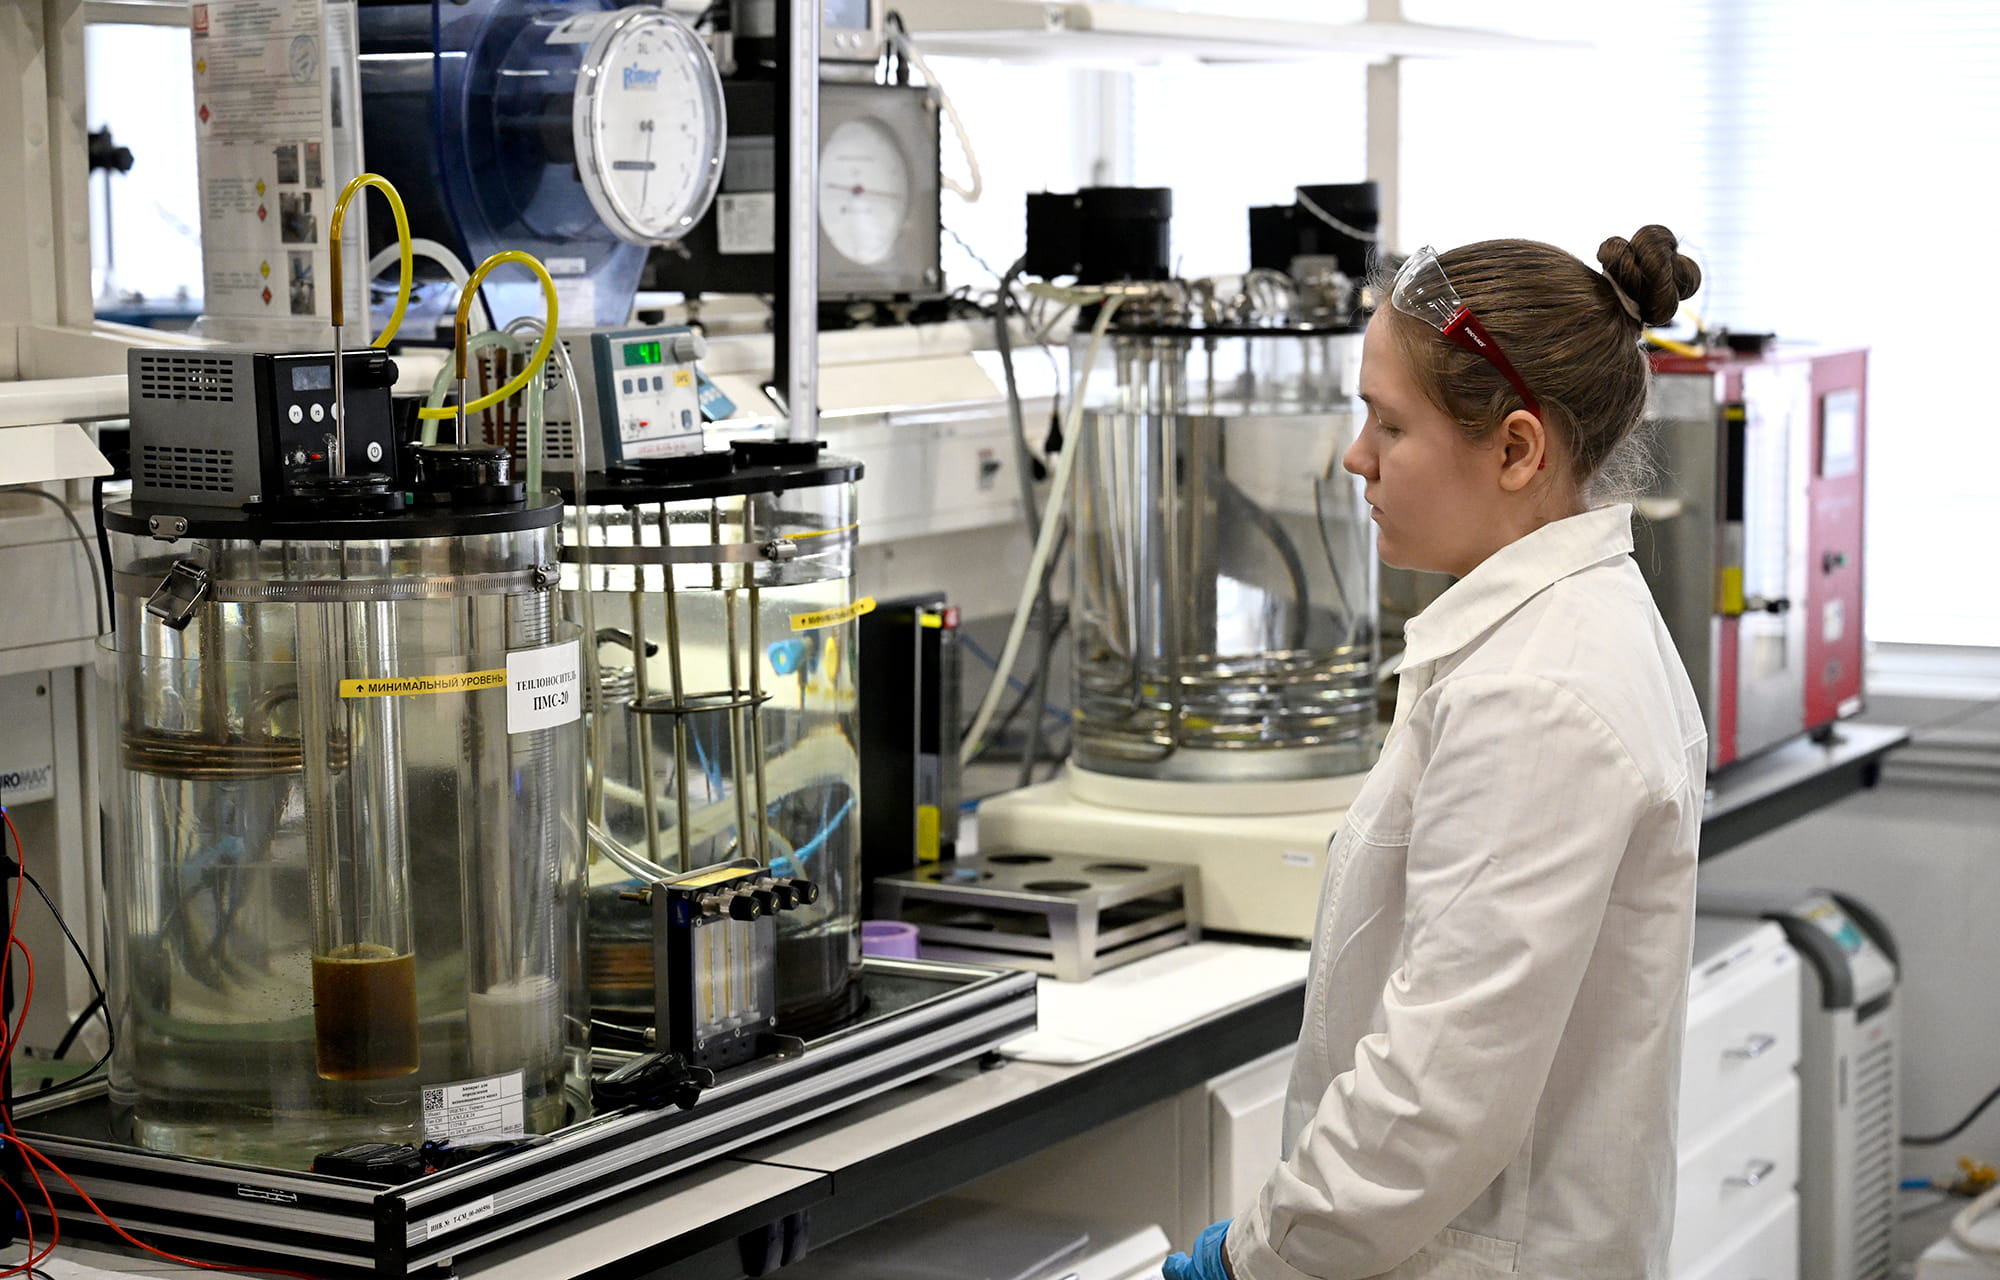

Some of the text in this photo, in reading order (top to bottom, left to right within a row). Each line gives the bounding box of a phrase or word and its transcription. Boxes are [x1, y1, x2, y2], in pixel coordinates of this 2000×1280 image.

[368, 674, 503, 693] МИНИМАЛЬНЫЙ УРОВЕНЬ
[516, 670, 577, 691] ТЕПЛОНОСИТЕЛЬ
[533, 690, 569, 711] ПМС-20
